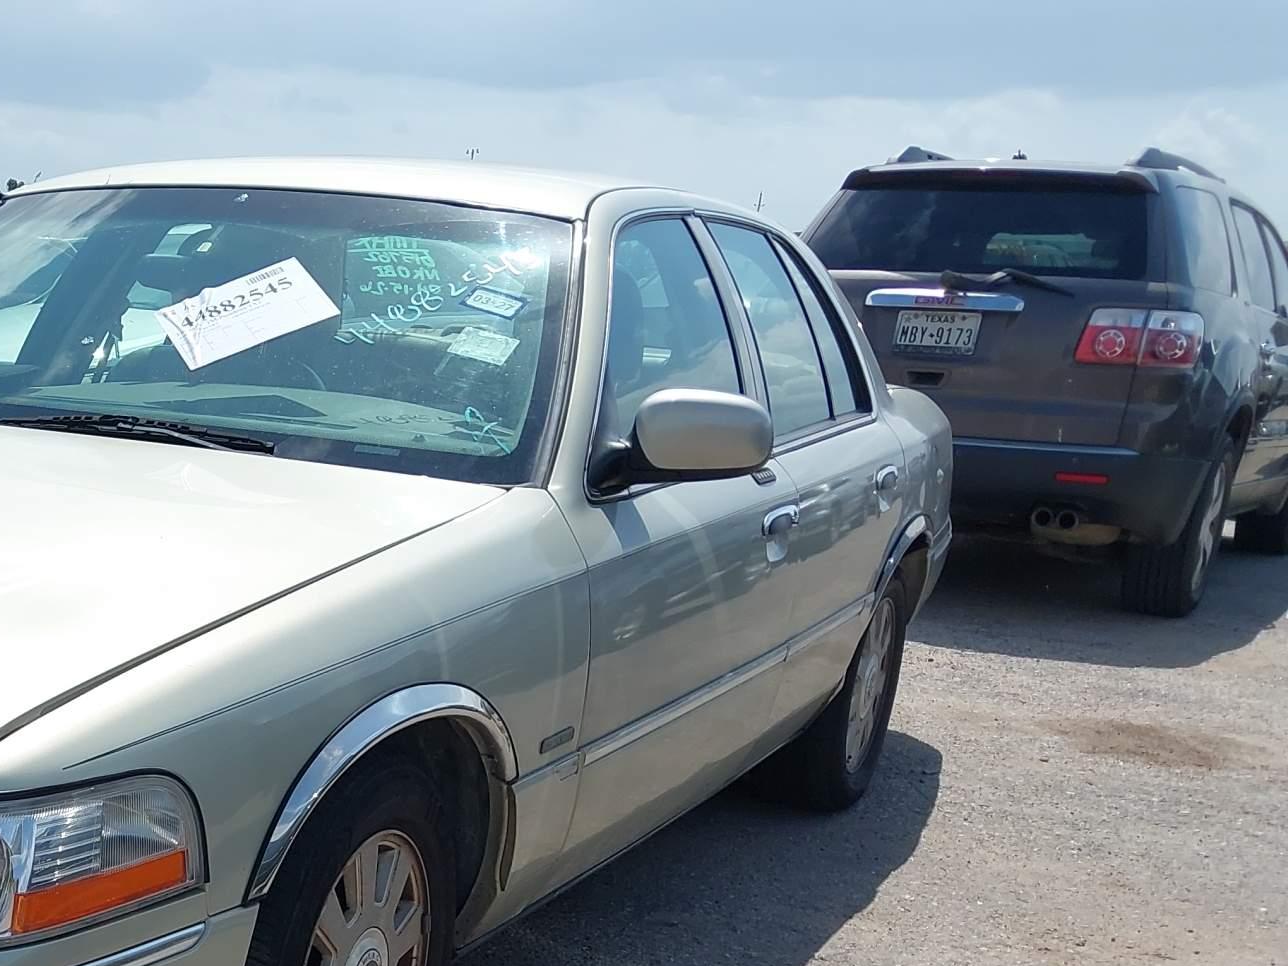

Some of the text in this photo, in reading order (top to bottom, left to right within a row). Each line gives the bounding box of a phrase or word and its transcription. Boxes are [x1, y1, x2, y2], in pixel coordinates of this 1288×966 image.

[181, 277, 293, 328] 44882545
[914, 296, 965, 306] GMC
[925, 314, 956, 324] TEXAS
